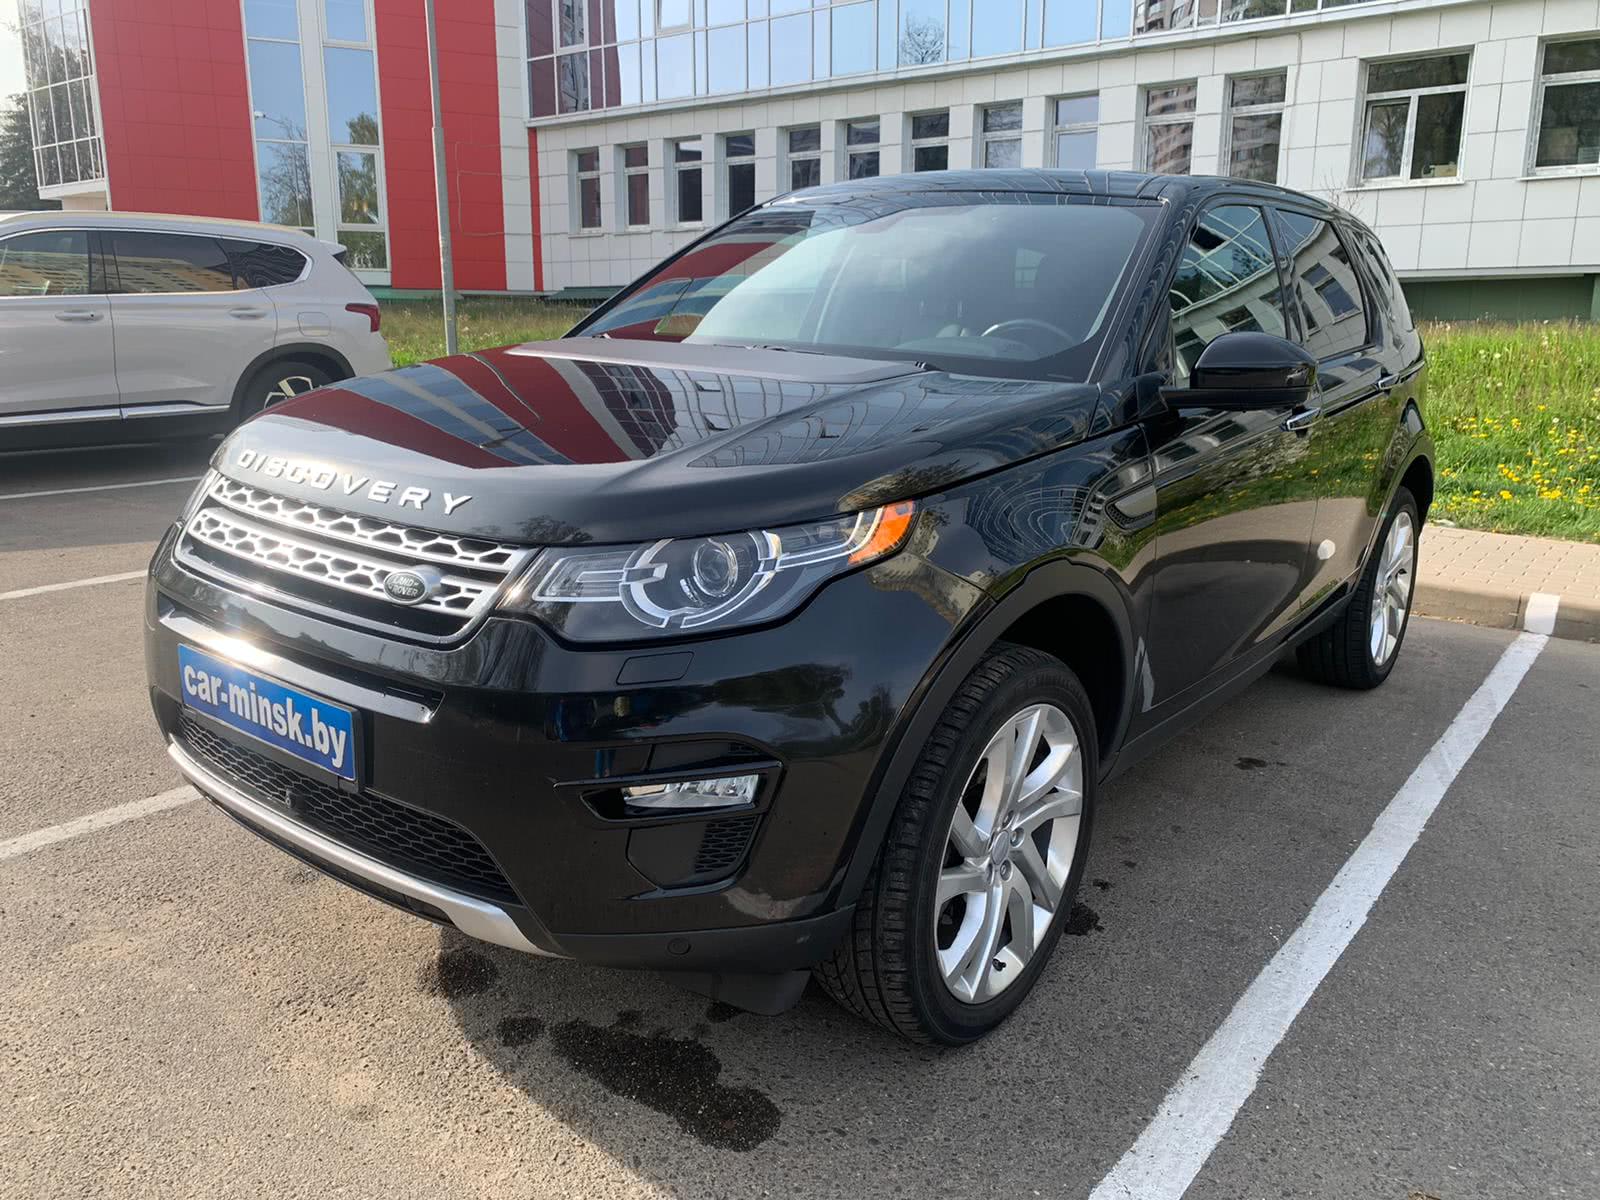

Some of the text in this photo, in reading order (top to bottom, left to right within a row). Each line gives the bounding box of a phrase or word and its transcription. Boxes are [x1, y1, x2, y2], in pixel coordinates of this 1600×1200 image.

[238, 450, 472, 515] DISCOVERY
[391, 584, 418, 597] ROVER
[393, 575, 414, 586] LAND
[184, 666, 347, 769] car-minsk.by
